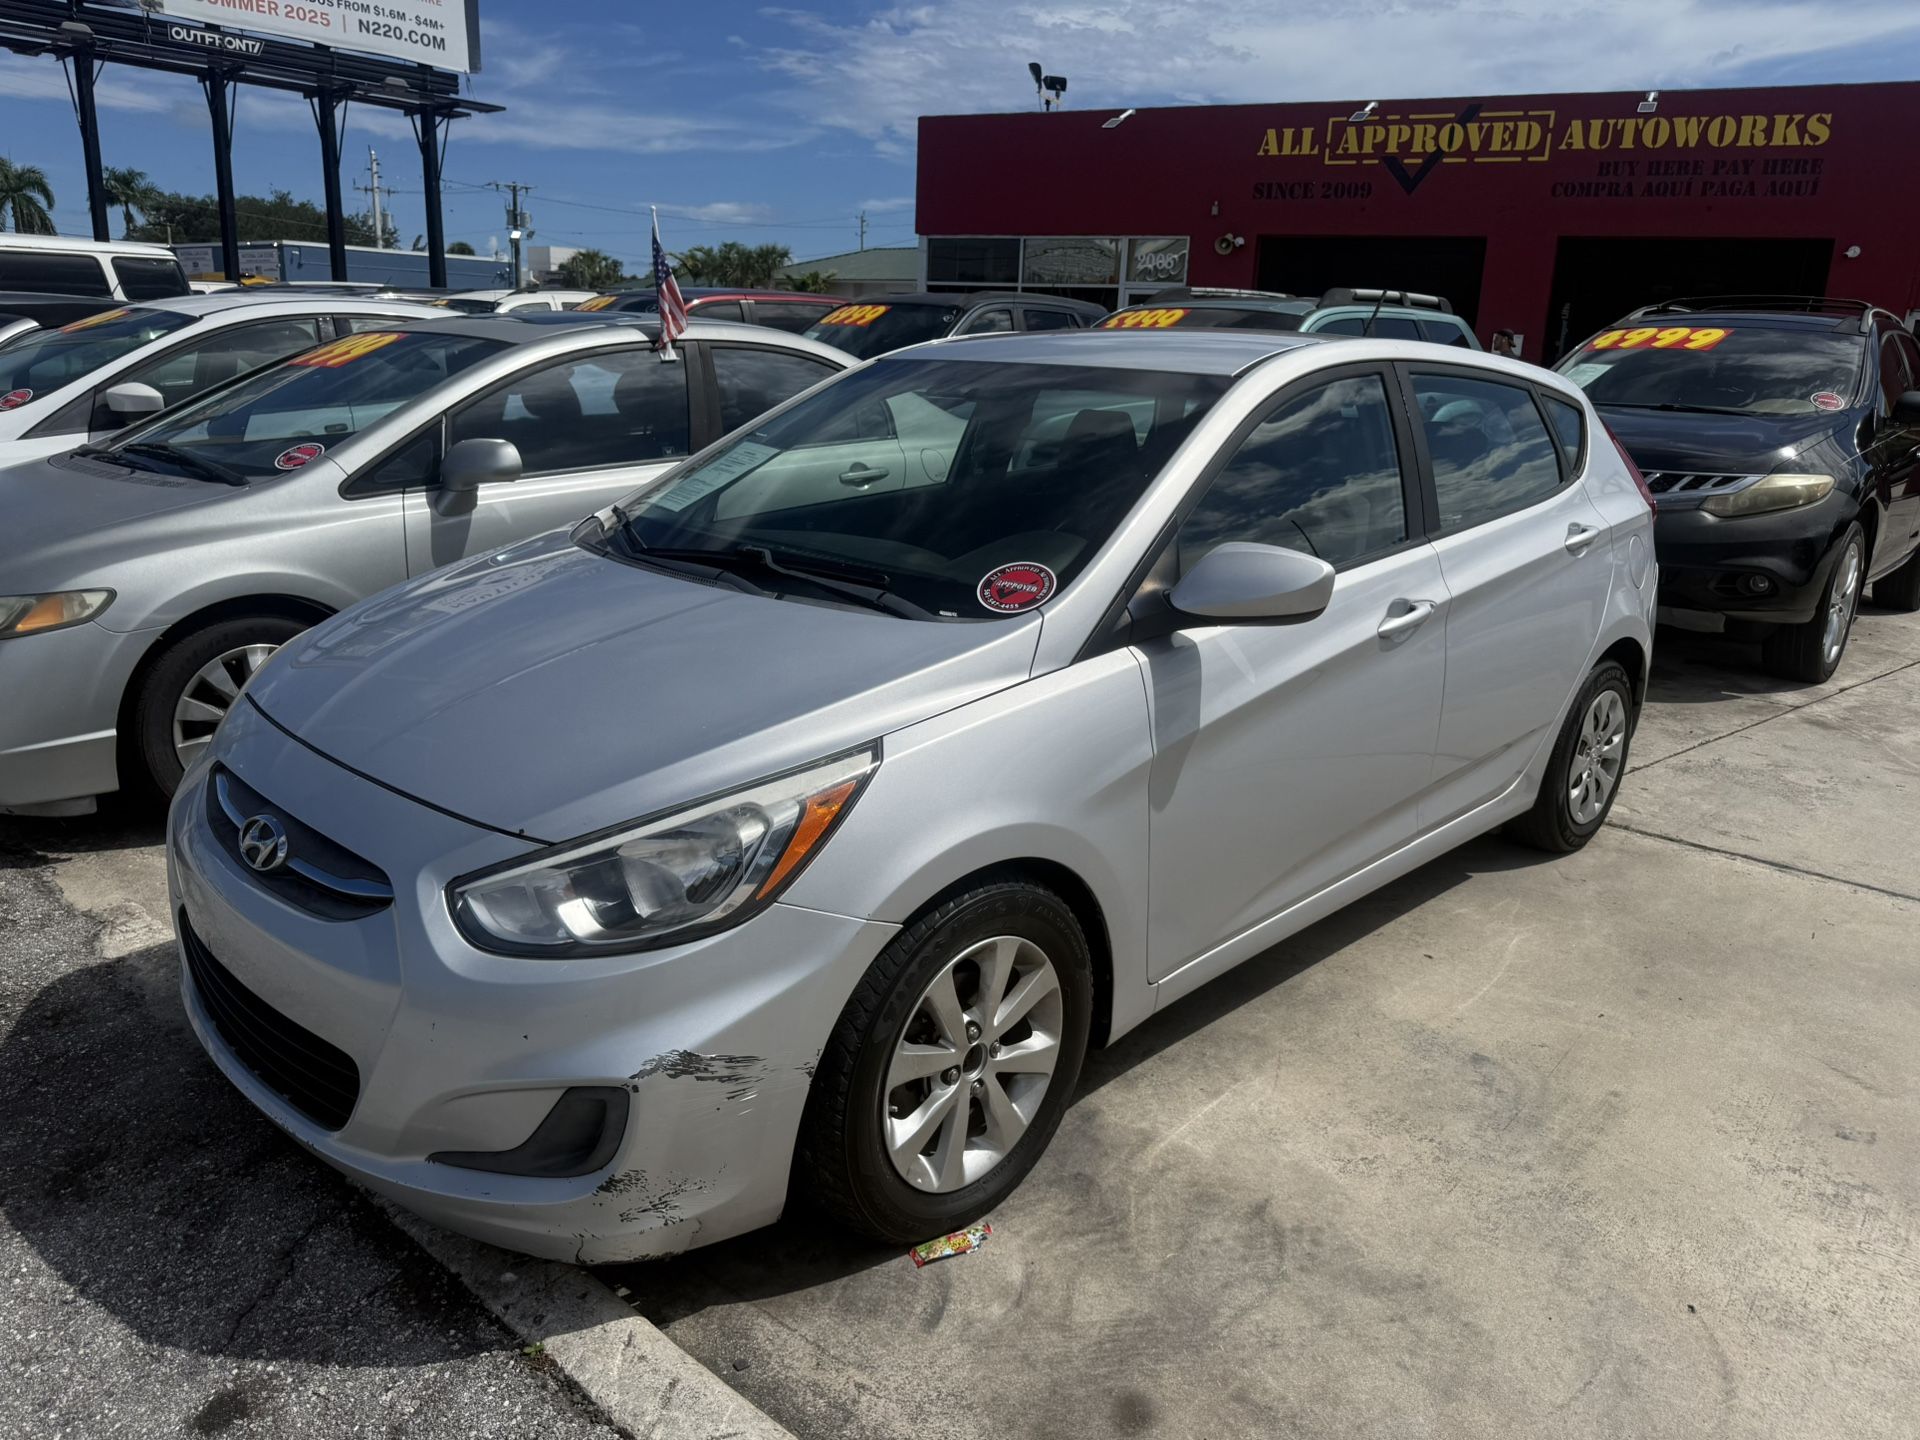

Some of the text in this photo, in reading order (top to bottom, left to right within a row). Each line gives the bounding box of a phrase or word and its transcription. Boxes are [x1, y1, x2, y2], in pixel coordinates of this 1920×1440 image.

[199, 0, 279, 16] MMER
[284, 4, 331, 27] 2025
[337, 0, 371, 14] FROM
[373, 7, 406, 22] $1.6M
[415, 14, 445, 30] $4M+
[358, 19, 446, 50] N220.COM
[1257, 113, 1832, 156] ALL APPROVED AUTOWORKS
[1597, 158, 1825, 177] BUY HERE PAY HERE
[1252, 181, 1372, 201] SINCE 2009
[1551, 182, 1634, 198] COMPRA
[1700, 180, 1756, 197] PAGA
[1593, 327, 1725, 350] 4999
